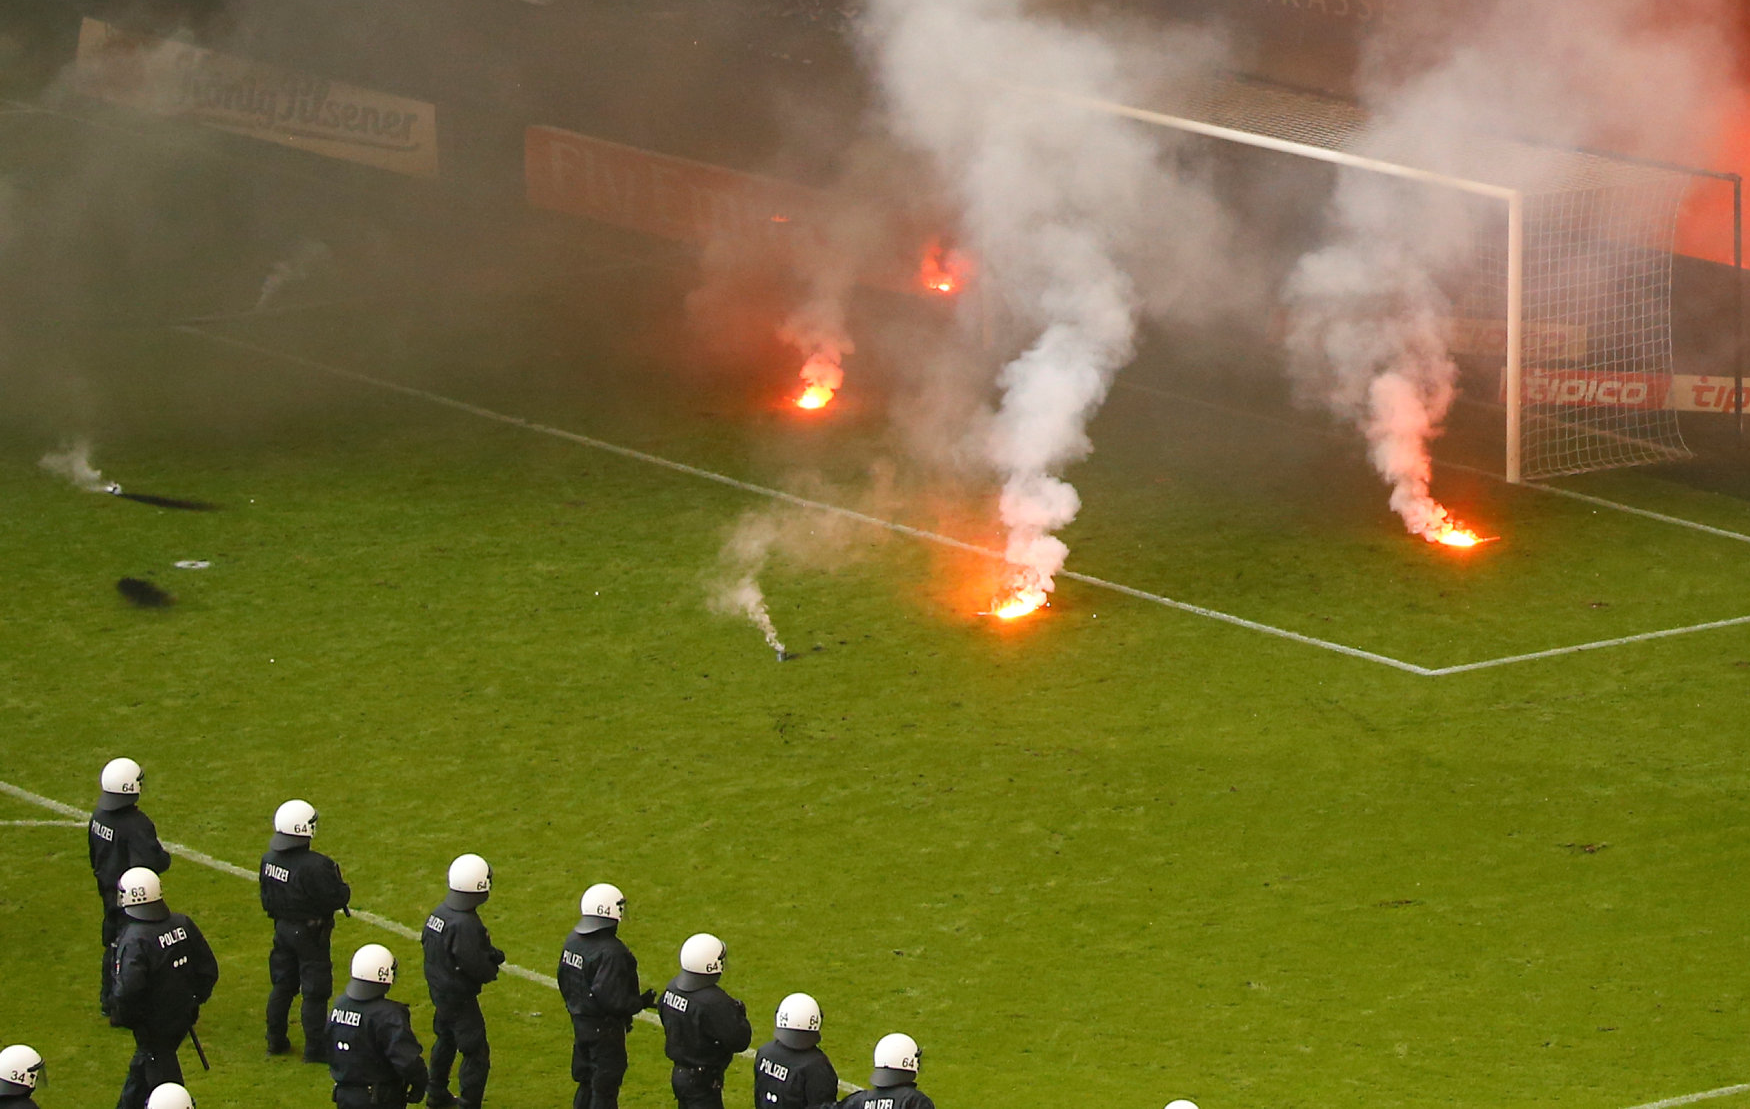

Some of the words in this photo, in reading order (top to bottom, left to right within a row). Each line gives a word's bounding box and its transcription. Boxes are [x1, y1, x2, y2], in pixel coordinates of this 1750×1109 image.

[1526, 369, 1648, 407] tipico
[121, 782, 135, 792] 64
[293, 823, 308, 833] 64
[131, 886, 146, 898] 63
[596, 904, 611, 916] 64
[158, 927, 188, 949] POLZEI
[377, 966, 390, 977] 64
[706, 961, 719, 972] 64
[663, 990, 689, 1012] POLIZEI
[331, 1008, 361, 1027] POLIZEI
[902, 1057, 915, 1068] 64
[760, 1057, 788, 1082] POLIZEI
[10, 1070, 26, 1083] 34
